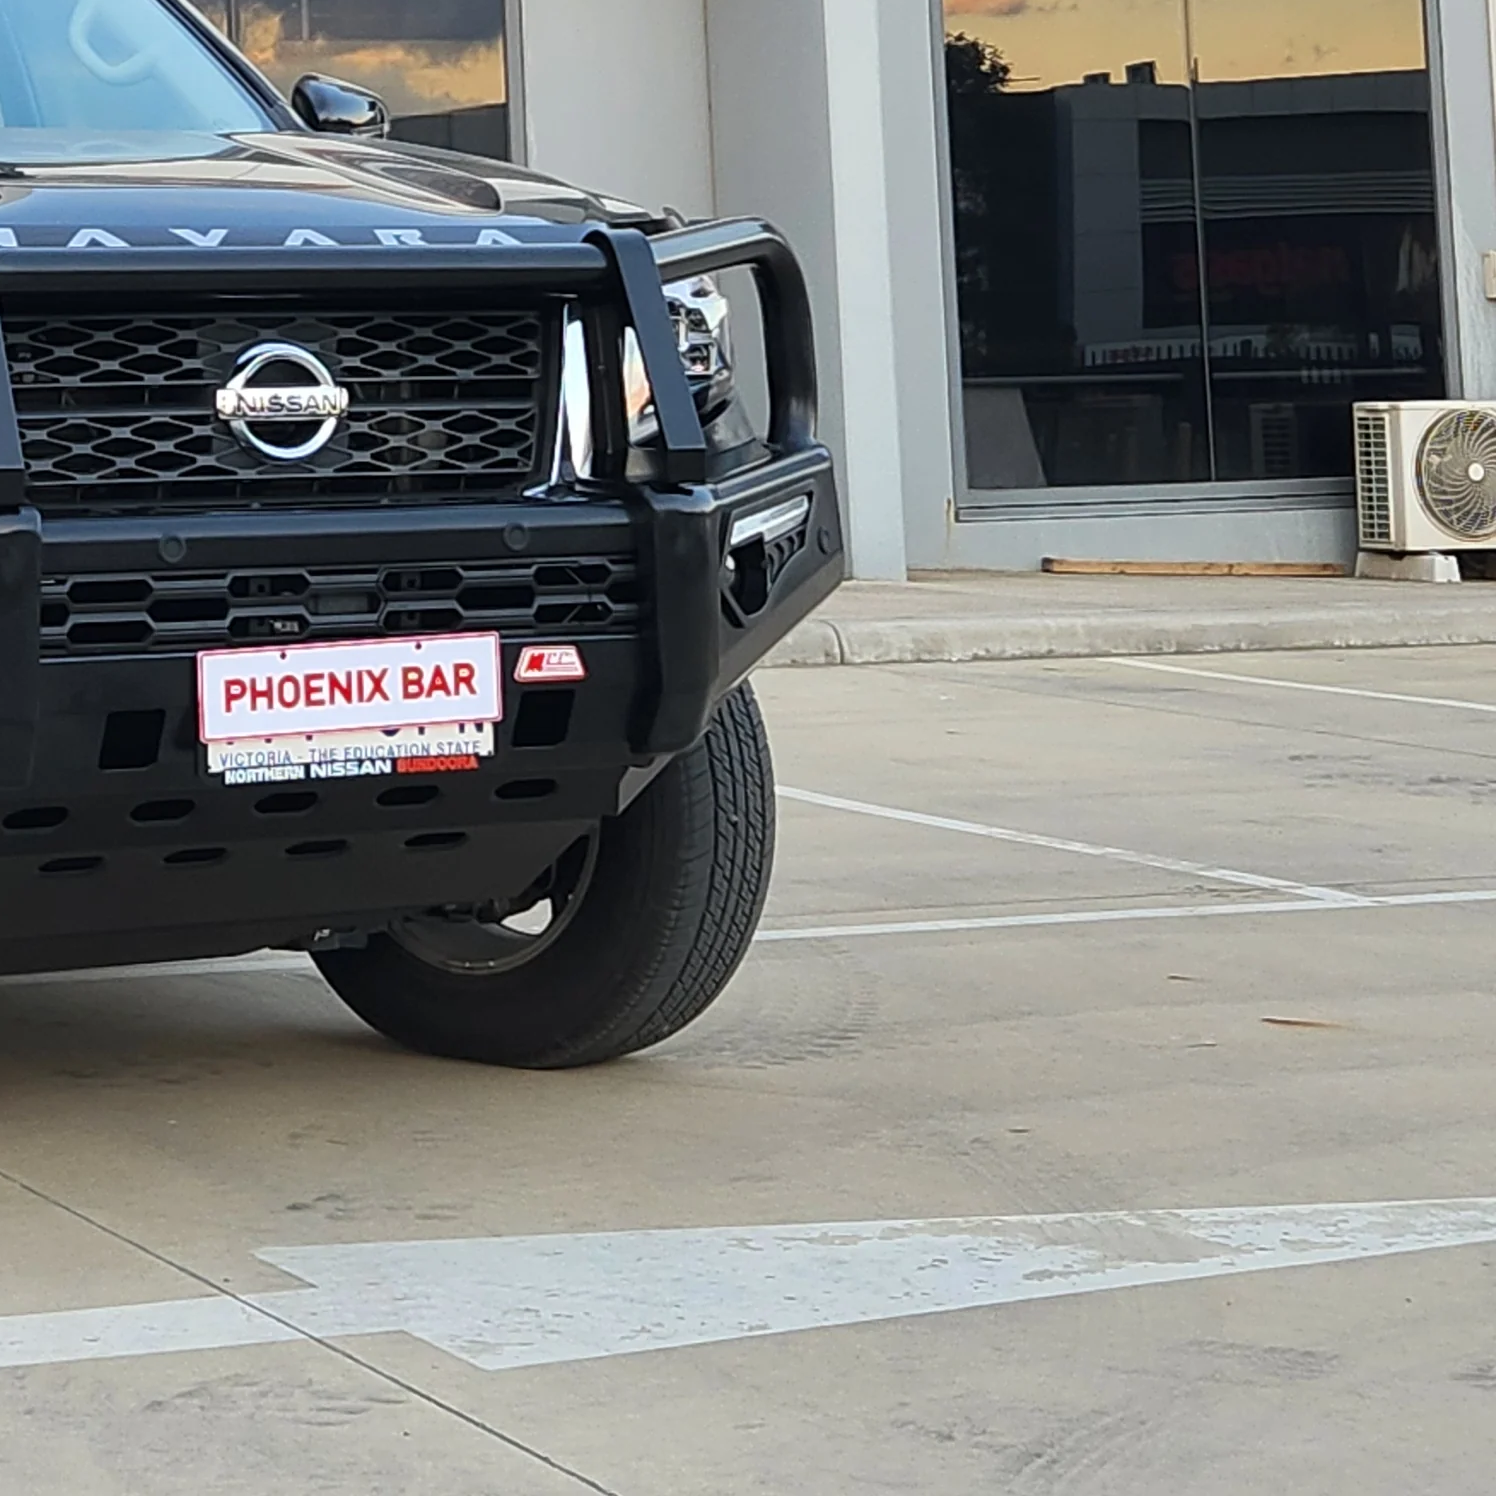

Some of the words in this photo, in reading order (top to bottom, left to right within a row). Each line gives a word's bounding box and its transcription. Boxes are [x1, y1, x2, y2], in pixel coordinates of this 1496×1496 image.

[236, 394, 338, 414] NISSAN
[223, 668, 390, 713] PHOENIX
[402, 662, 478, 700] BAR
[219, 749, 292, 768] VICTORIA
[308, 747, 338, 763] THE
[344, 742, 431, 760] EDUCATION
[436, 740, 481, 756] STATE
[224, 764, 305, 785] NORTHERN
[310, 759, 392, 779] NISSAN
